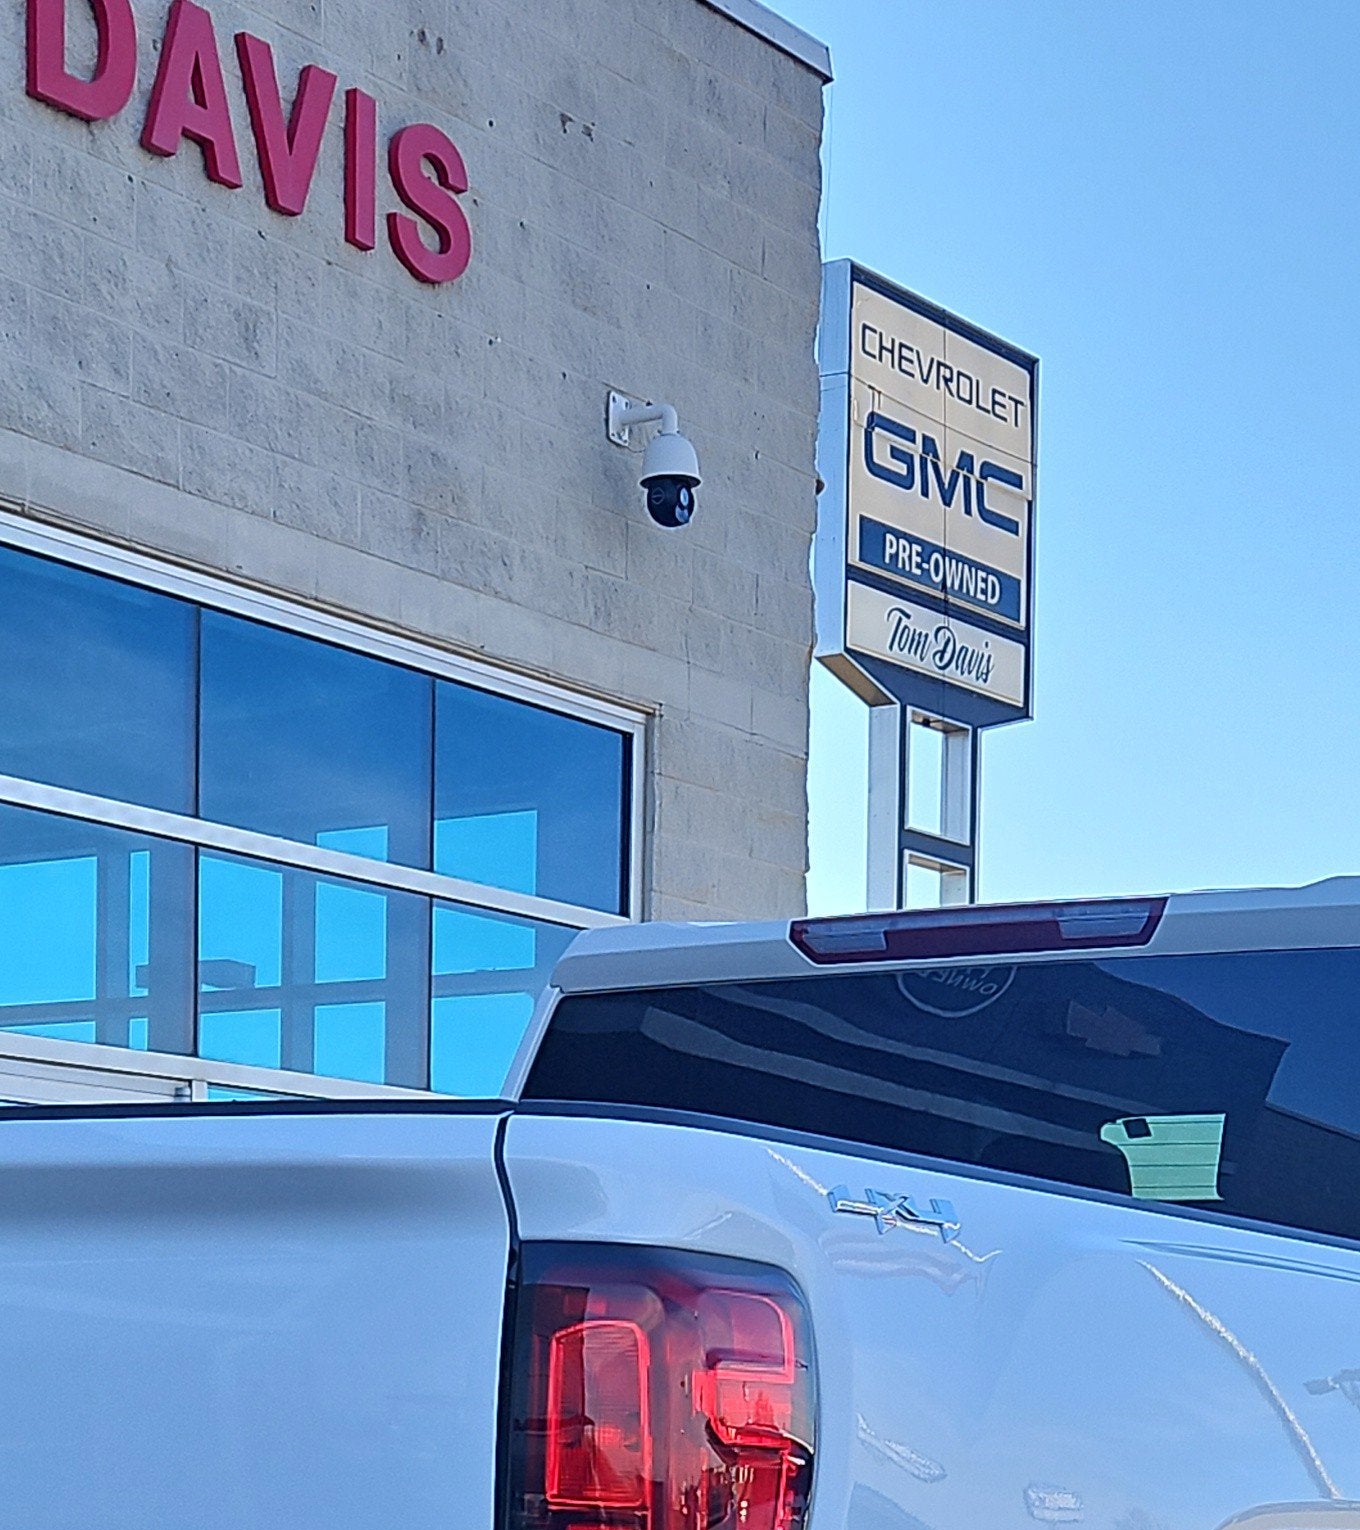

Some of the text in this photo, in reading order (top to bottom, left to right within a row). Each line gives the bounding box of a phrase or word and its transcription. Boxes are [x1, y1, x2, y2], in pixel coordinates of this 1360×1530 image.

[24, 0, 472, 284] DAVIS
[860, 321, 1025, 428] CHEVROLET
[863, 410, 1024, 537] GMC
[882, 532, 1001, 605] PRE-OWNED
[885, 606, 995, 684] Tom Davis
